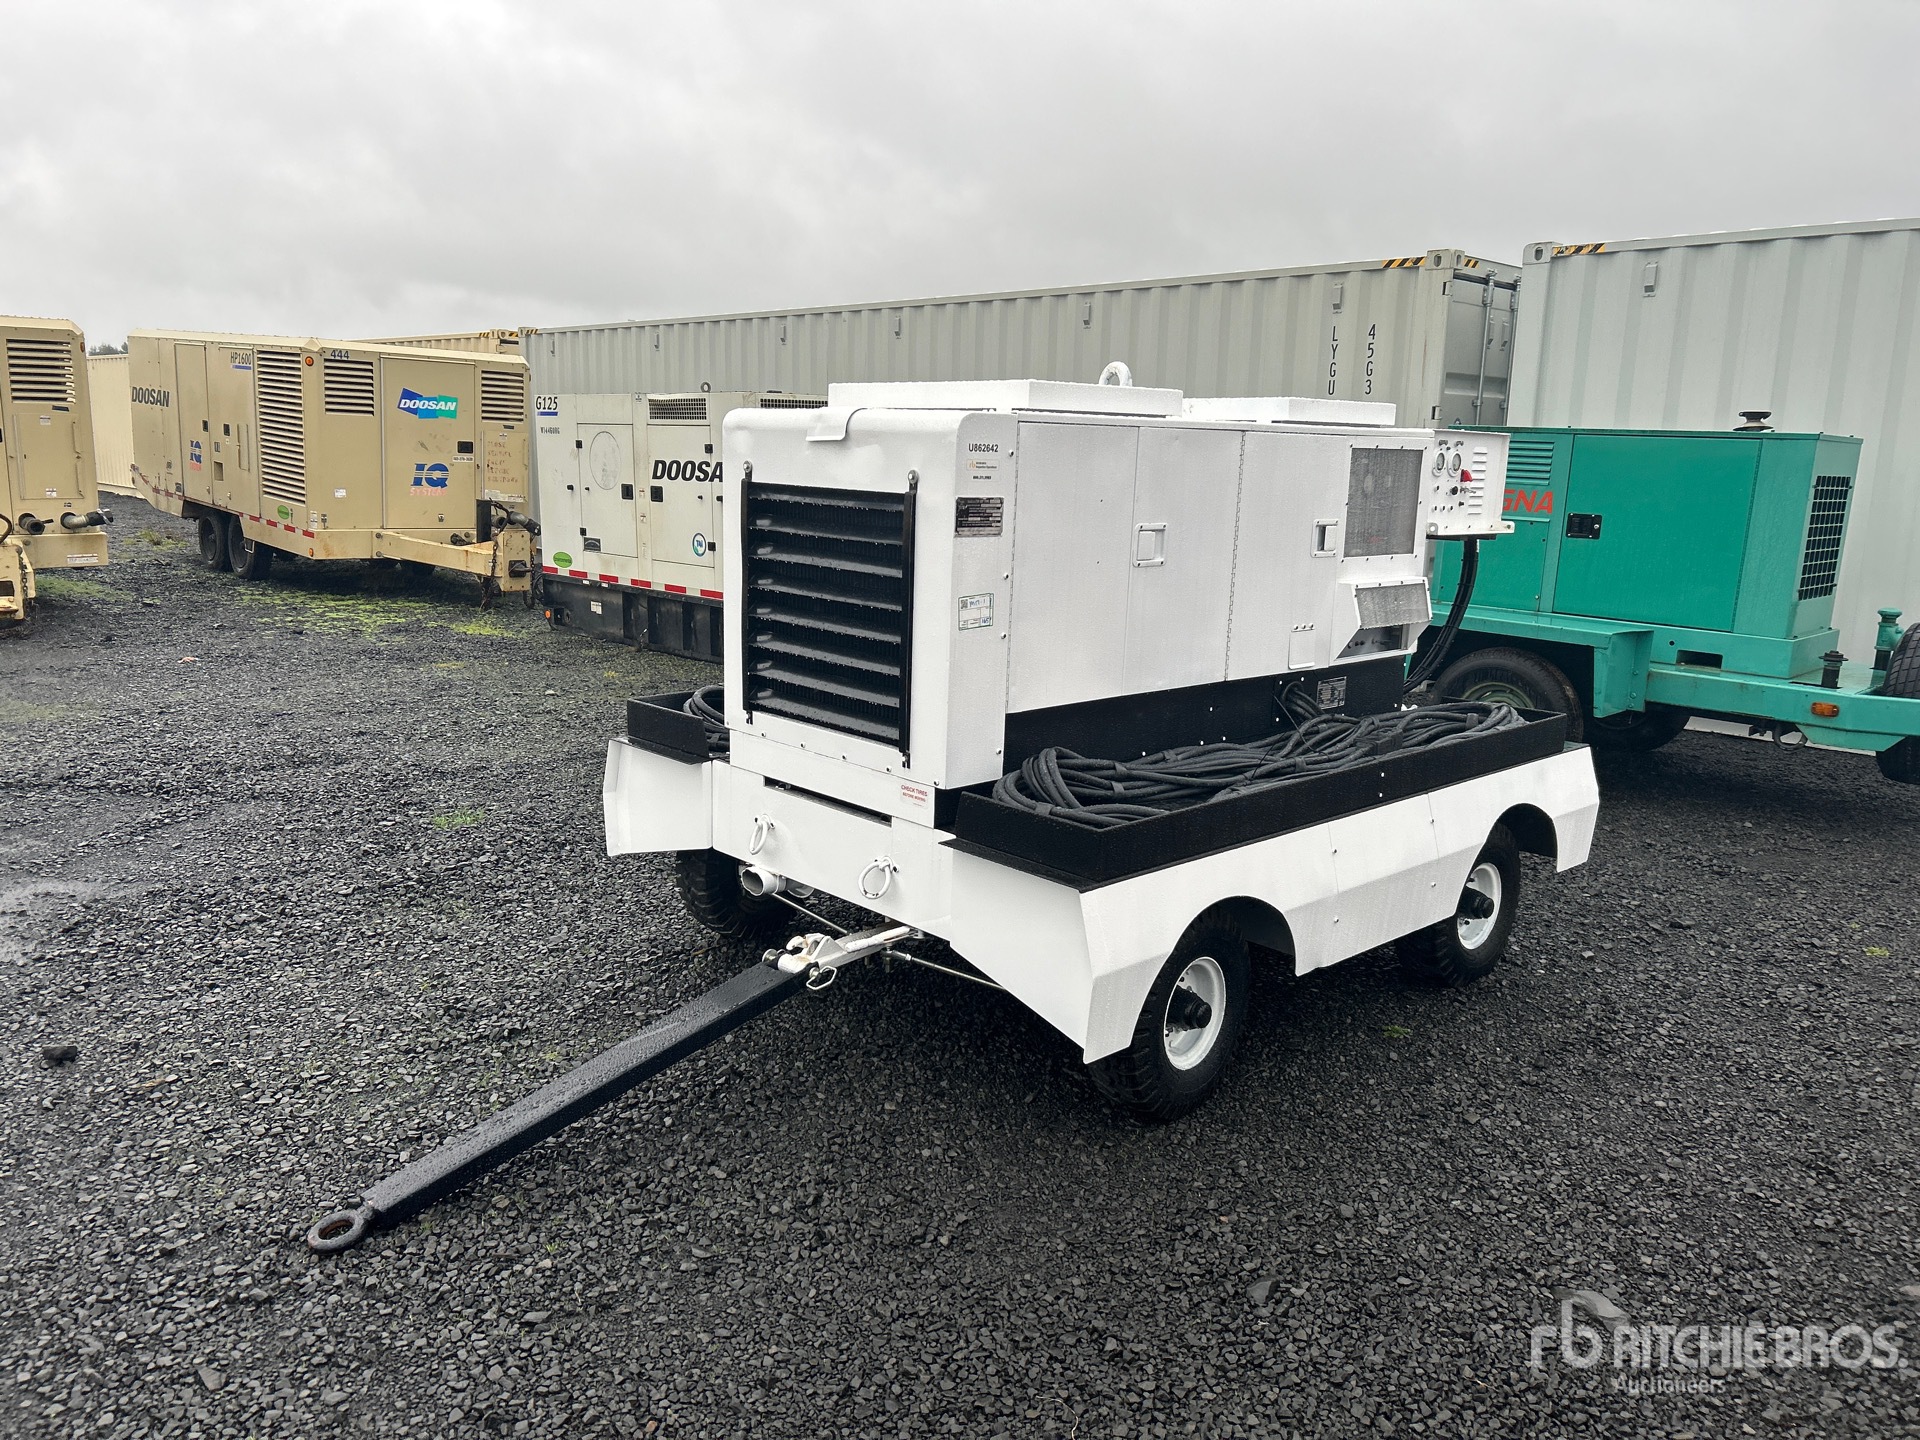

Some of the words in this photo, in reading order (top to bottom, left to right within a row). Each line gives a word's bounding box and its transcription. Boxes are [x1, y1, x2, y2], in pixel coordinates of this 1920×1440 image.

[230, 352, 252, 365] HP1600
[331, 350, 349, 359] 444
[1328, 326, 1338, 395] LYGU
[1365, 324, 1376, 395] 45G3
[131, 387, 170, 407] DOOSAN
[535, 396, 558, 411] G125
[399, 399, 457, 411] DOOSAN
[968, 443, 999, 453] U862642
[411, 463, 449, 488] IQ
